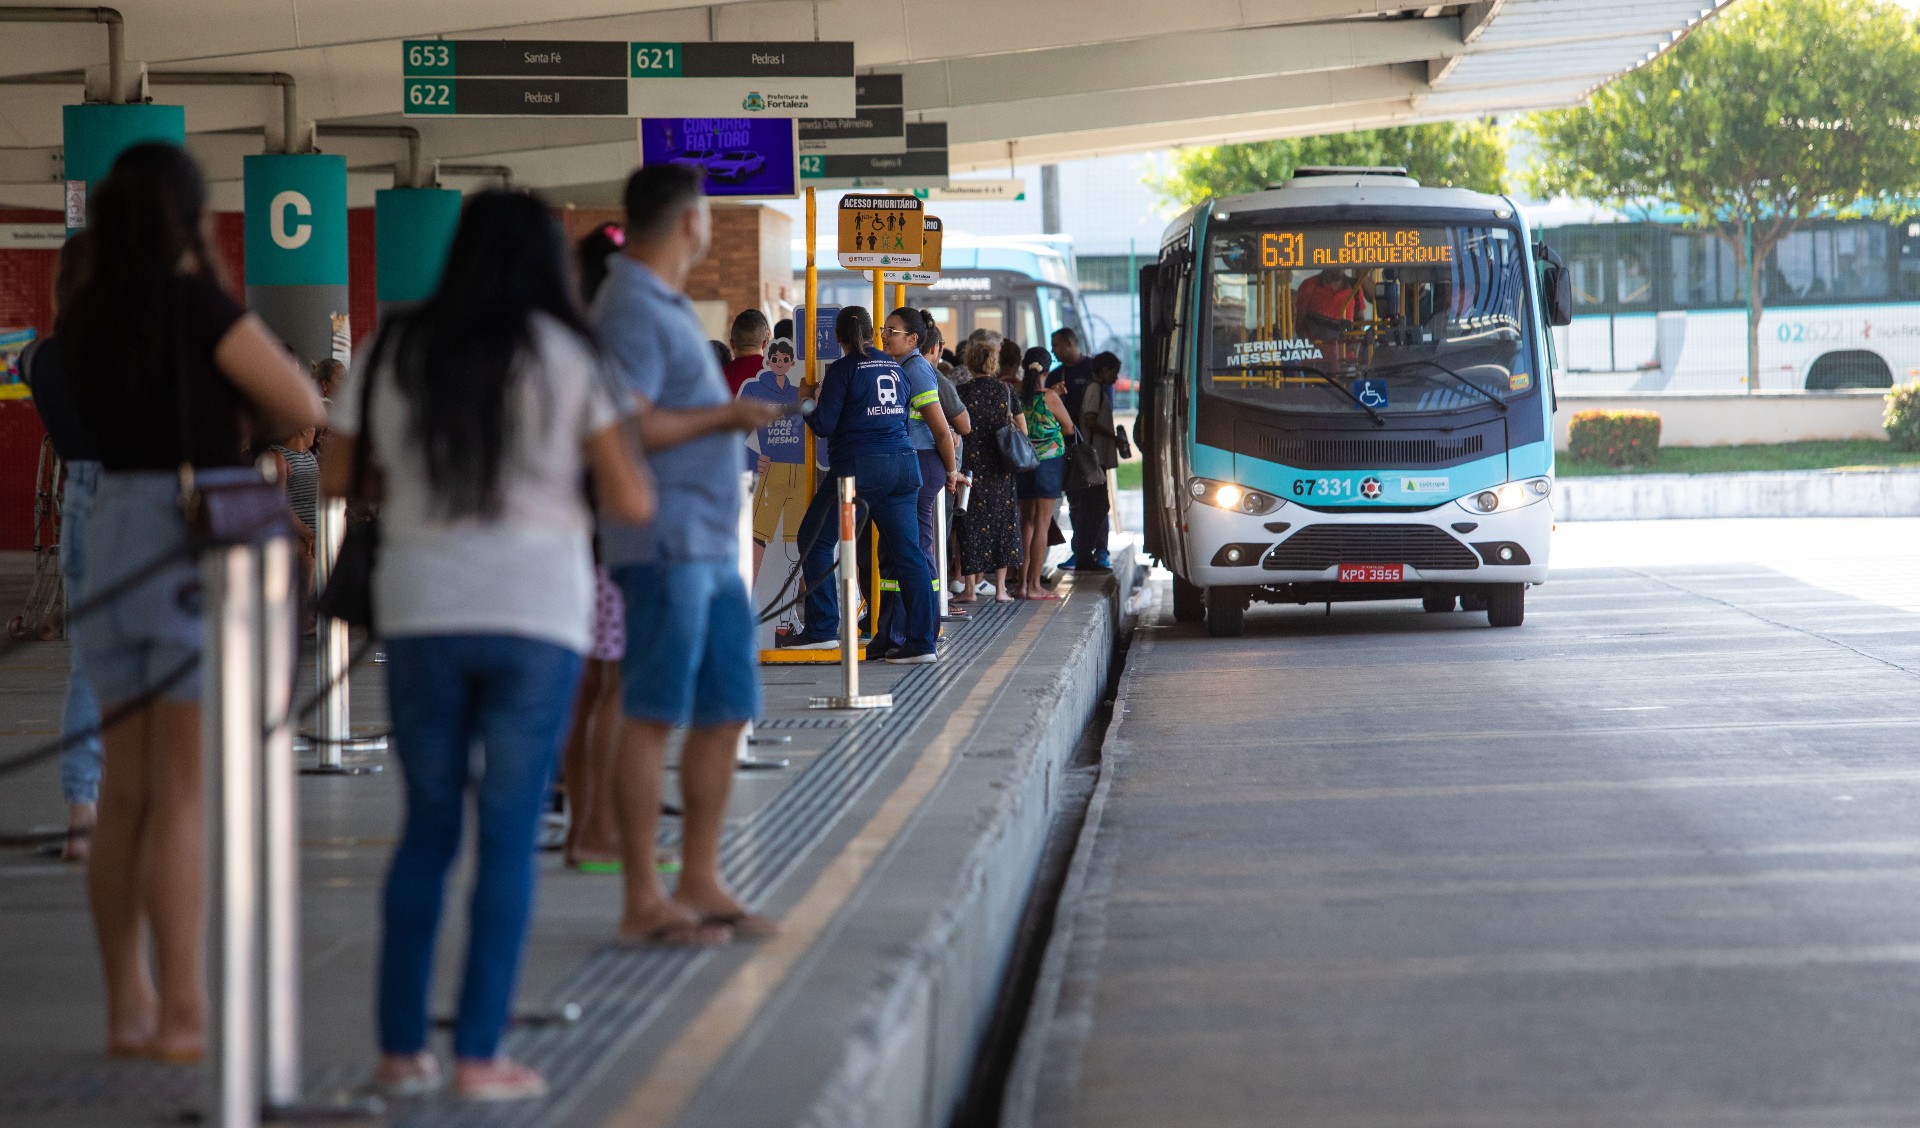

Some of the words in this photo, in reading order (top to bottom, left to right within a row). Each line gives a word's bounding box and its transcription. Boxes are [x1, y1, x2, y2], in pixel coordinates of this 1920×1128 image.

[409, 46, 449, 66] 653
[524, 52, 549, 64] Santa
[550, 51, 562, 64] Fé
[636, 48, 674, 69] 621
[752, 53, 780, 65] Pedras
[410, 85, 450, 105] 622
[524, 92, 553, 103] Pedras
[554, 92, 560, 103] II
[767, 100, 809, 108] Fortaleza
[823, 119, 838, 129] Das
[685, 133, 713, 151] FIAT
[718, 130, 750, 148] TORO
[800, 156, 821, 173] 42
[844, 198, 872, 208] ACESSO
[872, 197, 918, 209] PRIORITÁRIO
[269, 190, 313, 249] C
[1344, 230, 1420, 248] CARLOS
[1262, 233, 1304, 267] 631
[1313, 245, 1453, 265] ALBUQUERQUE
[1233, 338, 1315, 354] TERMINAL
[1226, 348, 1324, 367] MESSEJANA
[774, 419, 793, 428] PRA
[767, 435, 800, 445] MESMO
[1292, 478, 1351, 496] 67331
[1342, 569, 1365, 580] KPQ
[1369, 569, 1400, 580] 3955
